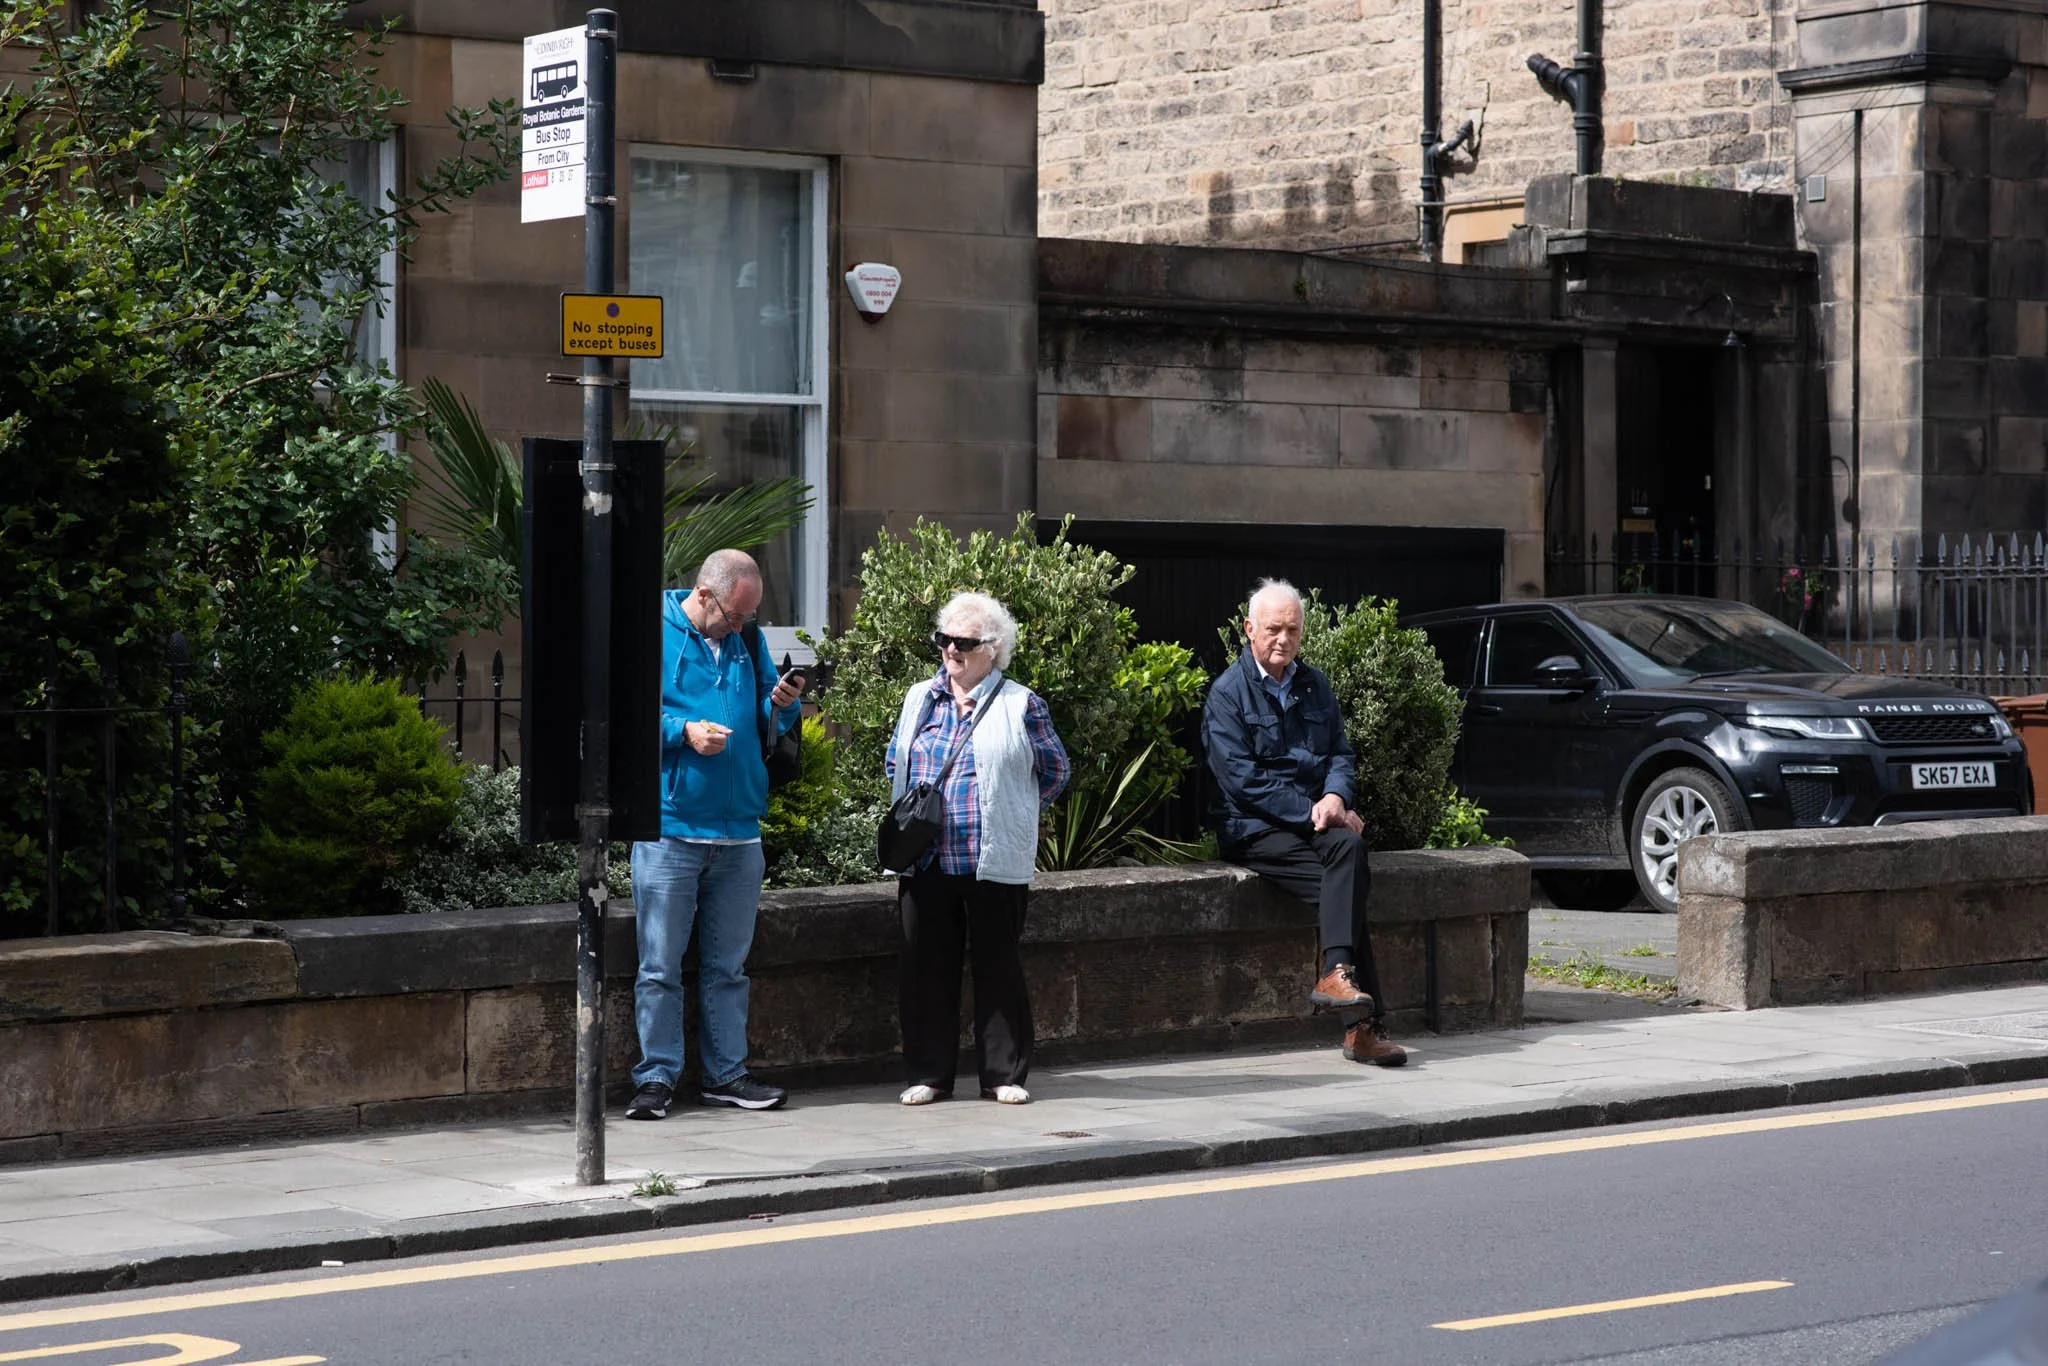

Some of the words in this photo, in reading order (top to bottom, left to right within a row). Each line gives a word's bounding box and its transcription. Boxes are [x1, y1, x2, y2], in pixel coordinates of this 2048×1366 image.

[523, 112, 539, 127] Royal
[539, 108, 560, 122] Botanic
[560, 105, 585, 118] Gardens
[536, 129, 551, 144] Bus
[553, 126, 571, 142] Stop
[538, 153, 555, 165] From
[556, 150, 570, 164] City
[524, 174, 546, 186] Lothian
[573, 321, 592, 333] No
[597, 322, 653, 337] stopping
[569, 338, 613, 350] except
[619, 338, 657, 350] buses
[1857, 705, 1923, 713] RANGE
[1932, 704, 1986, 712] ROVER
[1918, 766, 1959, 785] SK67
[1962, 765, 1990, 784] EXA
